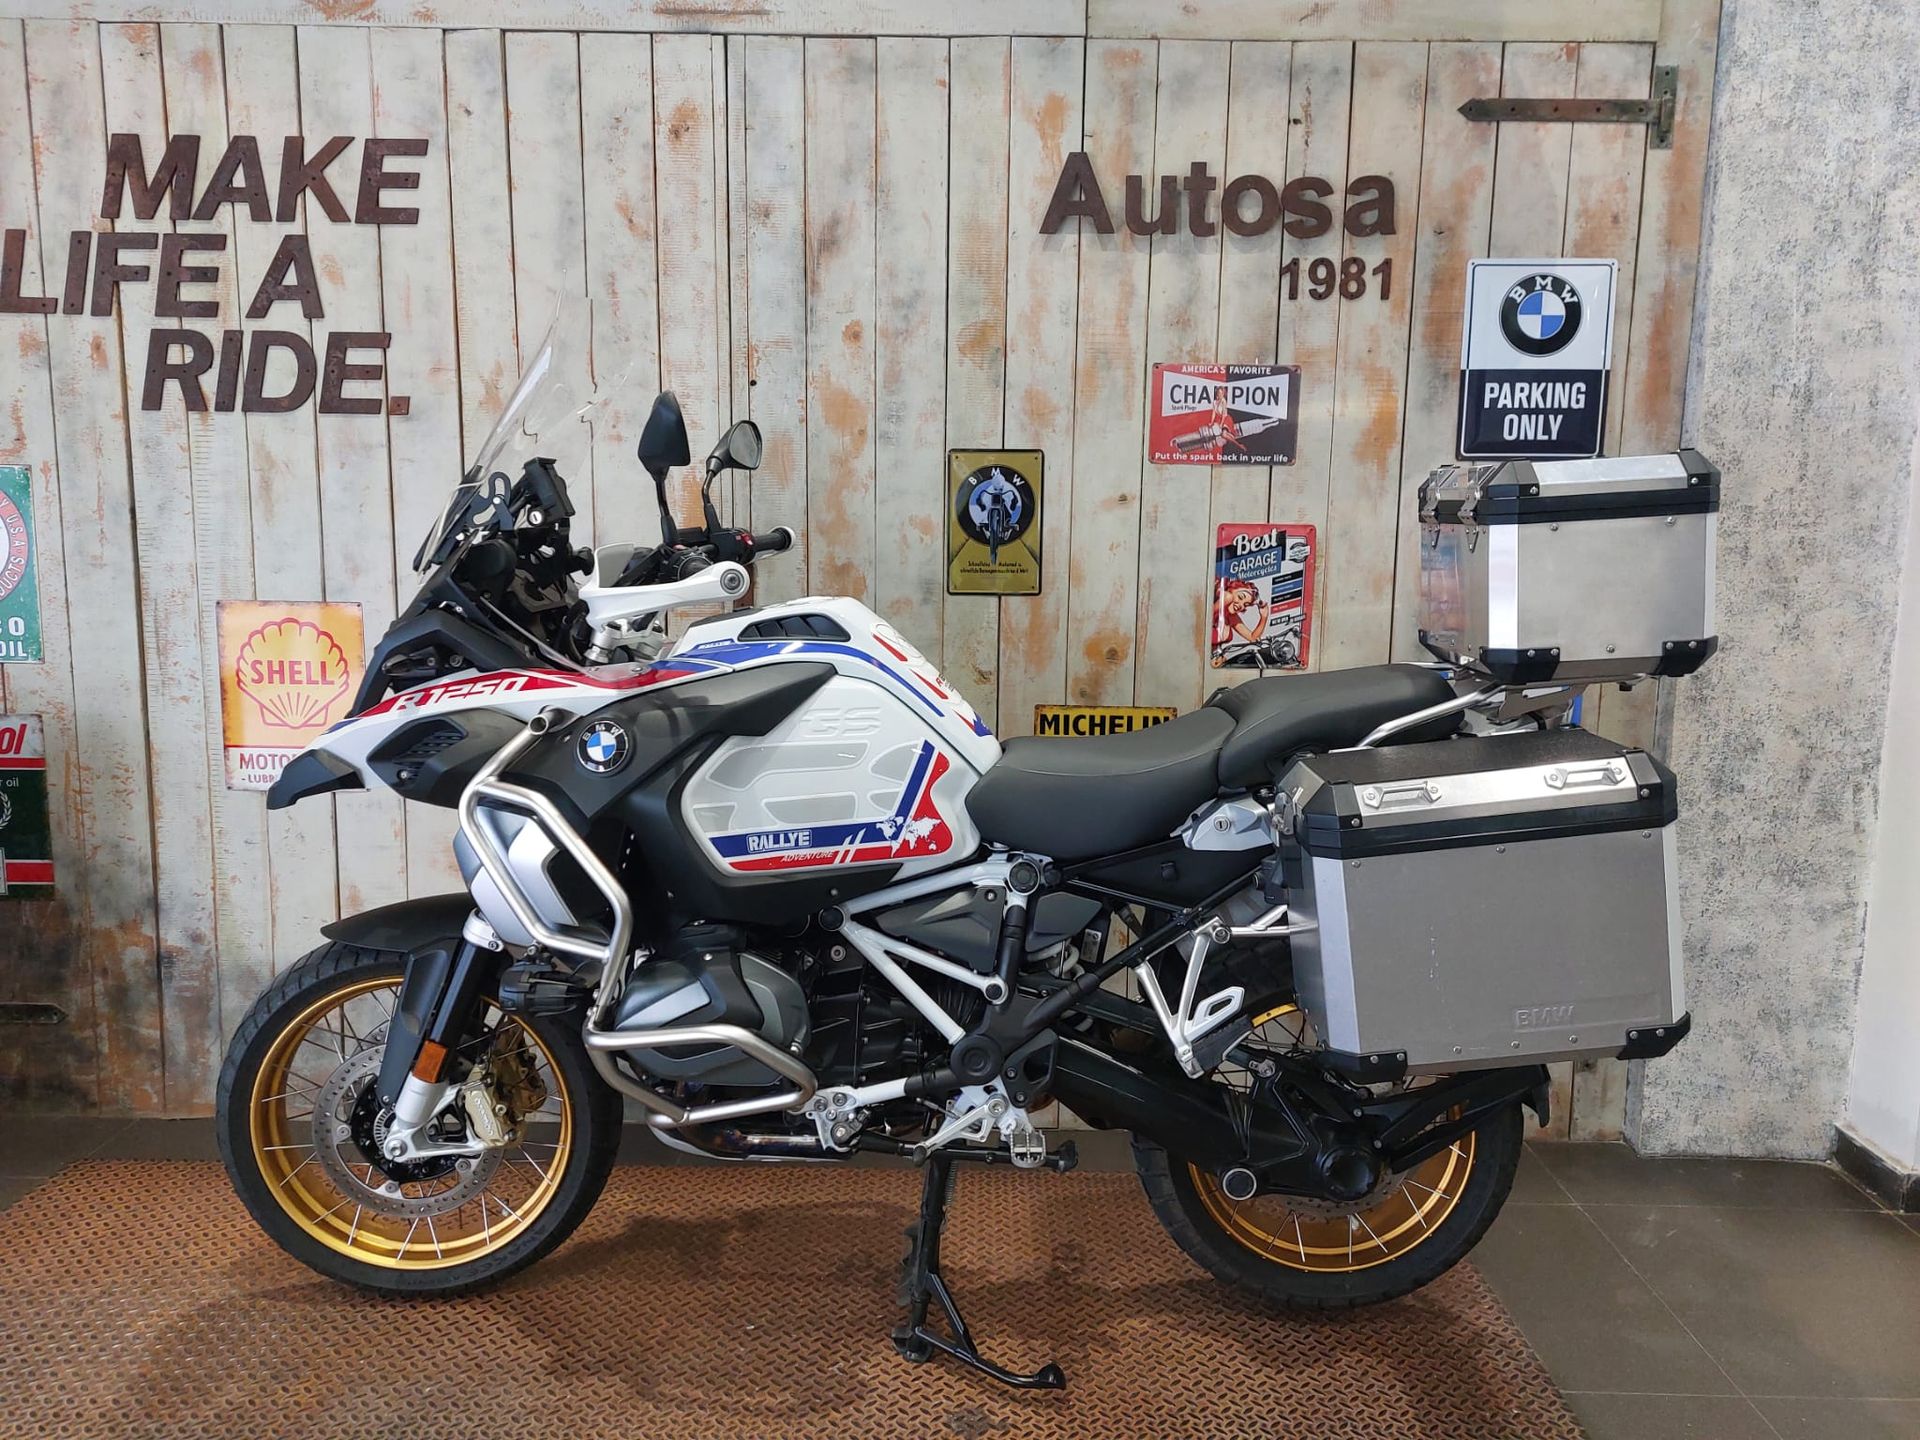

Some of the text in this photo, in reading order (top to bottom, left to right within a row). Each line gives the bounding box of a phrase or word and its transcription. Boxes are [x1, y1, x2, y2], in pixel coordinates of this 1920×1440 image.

[100, 133, 429, 225] MAKE
[1038, 151, 1397, 239] Autosa
[0, 229, 324, 319] LIFE A
[1280, 257, 1392, 301] 1981
[1508, 275, 1579, 304] BMW
[141, 328, 411, 416] RIDE.
[1181, 365, 1272, 375] AMERICA'S FAVORITE
[1483, 382, 1586, 409] PARKING
[1502, 414, 1563, 441] ONLY
[1155, 452, 1288, 463] Put the spark back in your life
[967, 467, 1025, 487] BMW
[1233, 528, 1279, 555] Best
[1230, 551, 1278, 573] GARAGE
[250, 659, 335, 686] SHELL
[800, 706, 882, 738] GS
[239, 752, 297, 770] MOTO
[748, 831, 810, 852] RALLYE
[781, 851, 834, 862] ADVENTURE
